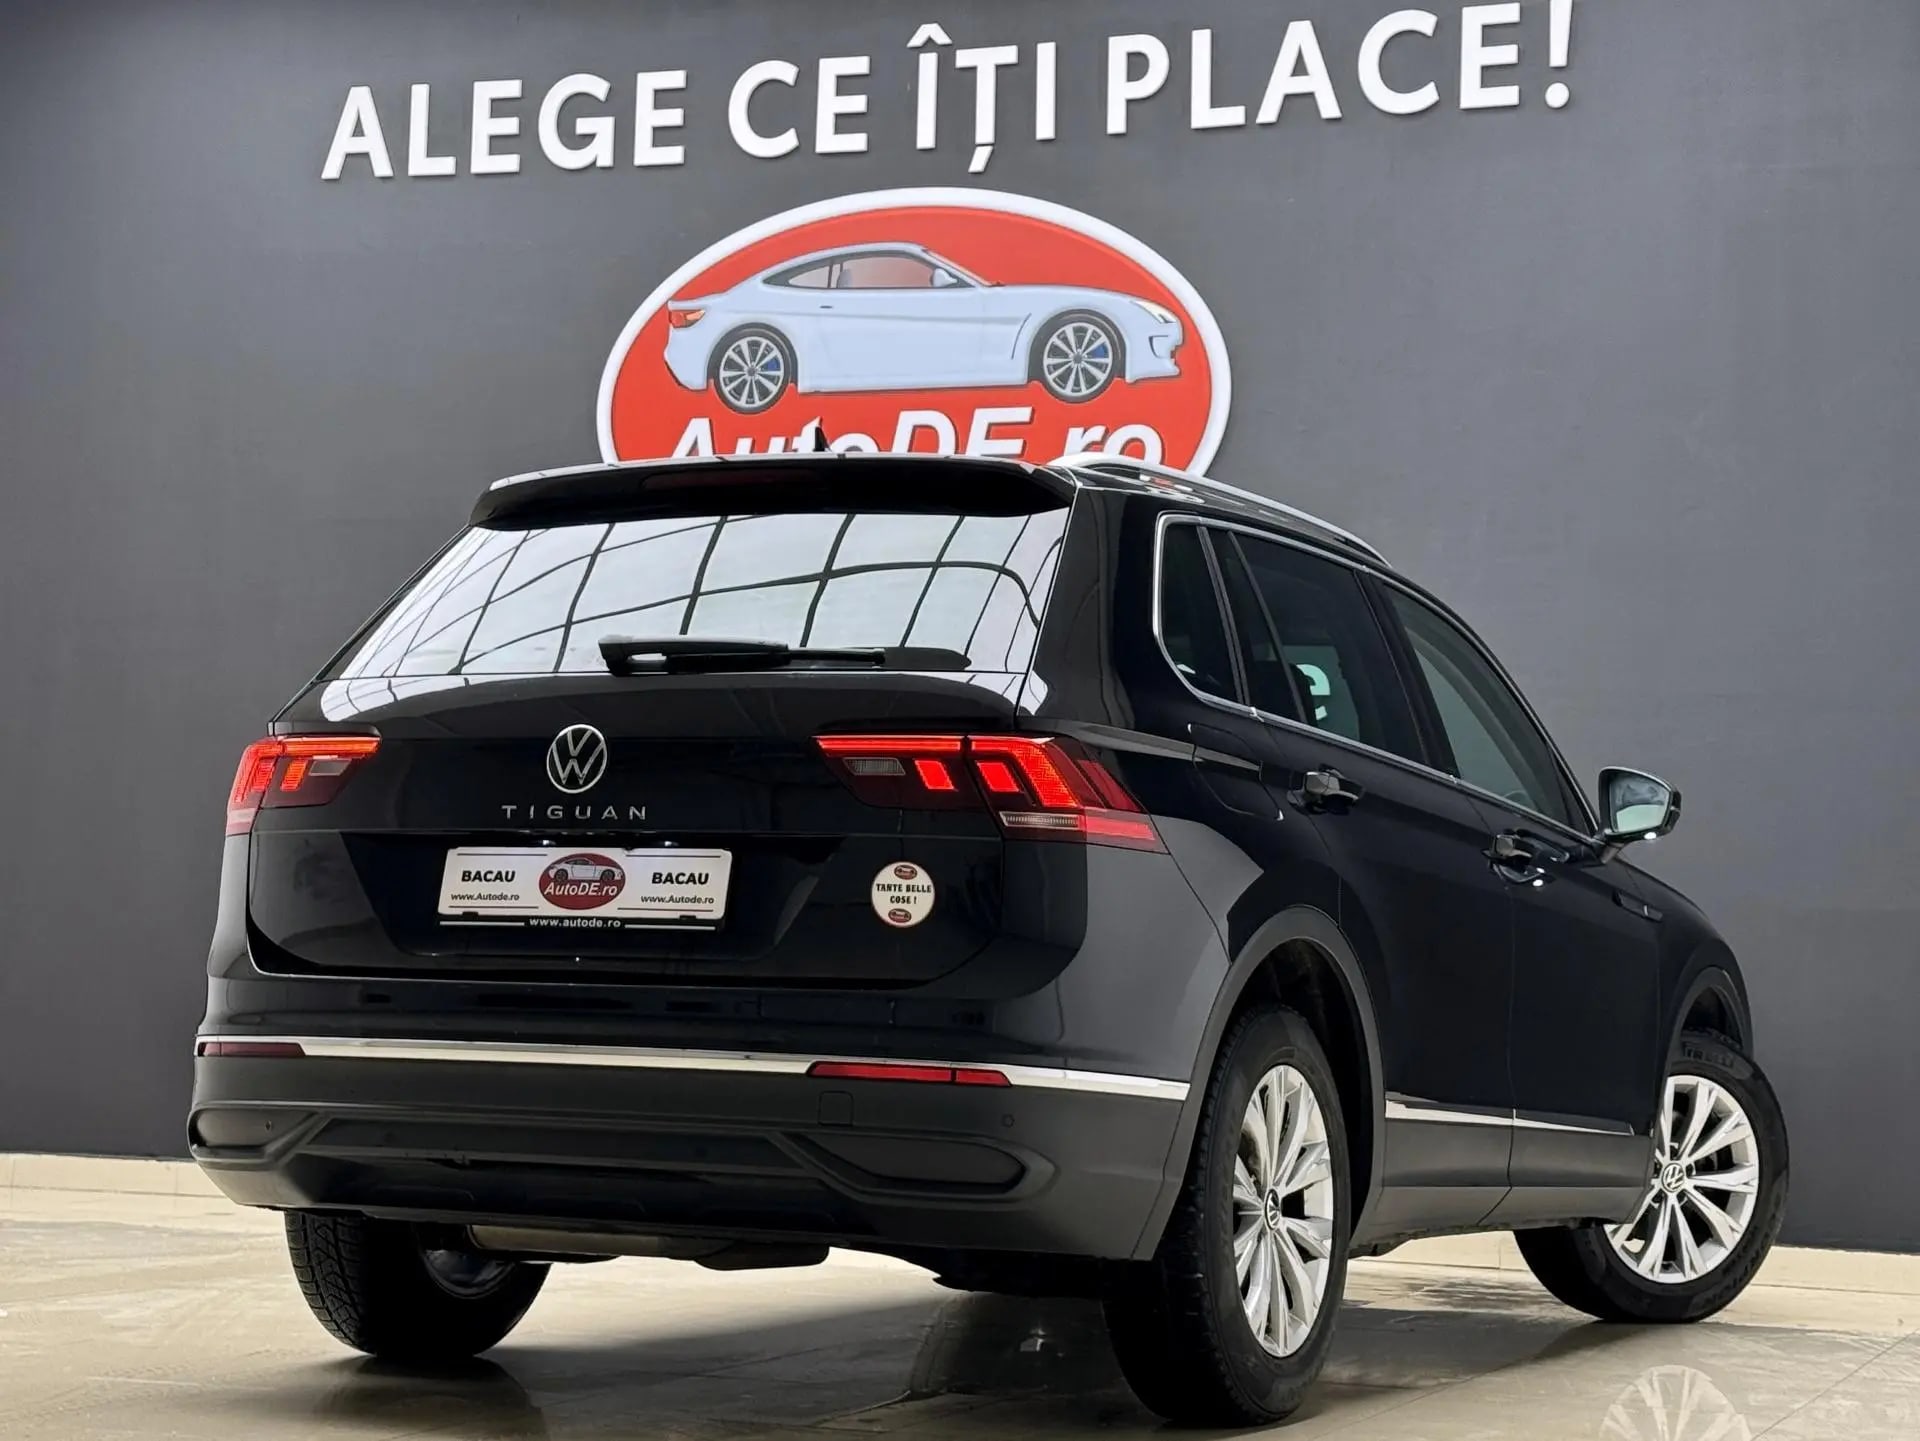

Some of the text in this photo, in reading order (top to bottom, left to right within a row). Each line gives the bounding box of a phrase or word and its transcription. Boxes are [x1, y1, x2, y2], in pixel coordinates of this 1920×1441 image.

[321, 0, 1573, 180] ALEGE CE ÎȚI PLACE!
[501, 805, 646, 820] TIGUAN
[461, 870, 516, 883] BACAU
[651, 872, 709, 885] BACAU
[544, 882, 618, 896] AutoDE.ro
[876, 883, 932, 893] TANTE BELLE
[450, 892, 520, 901] www.Autode.ro
[640, 895, 715, 904] www.Autode.ro
[889, 895, 912, 904] COSE
[529, 917, 621, 928] www.autode.ro
